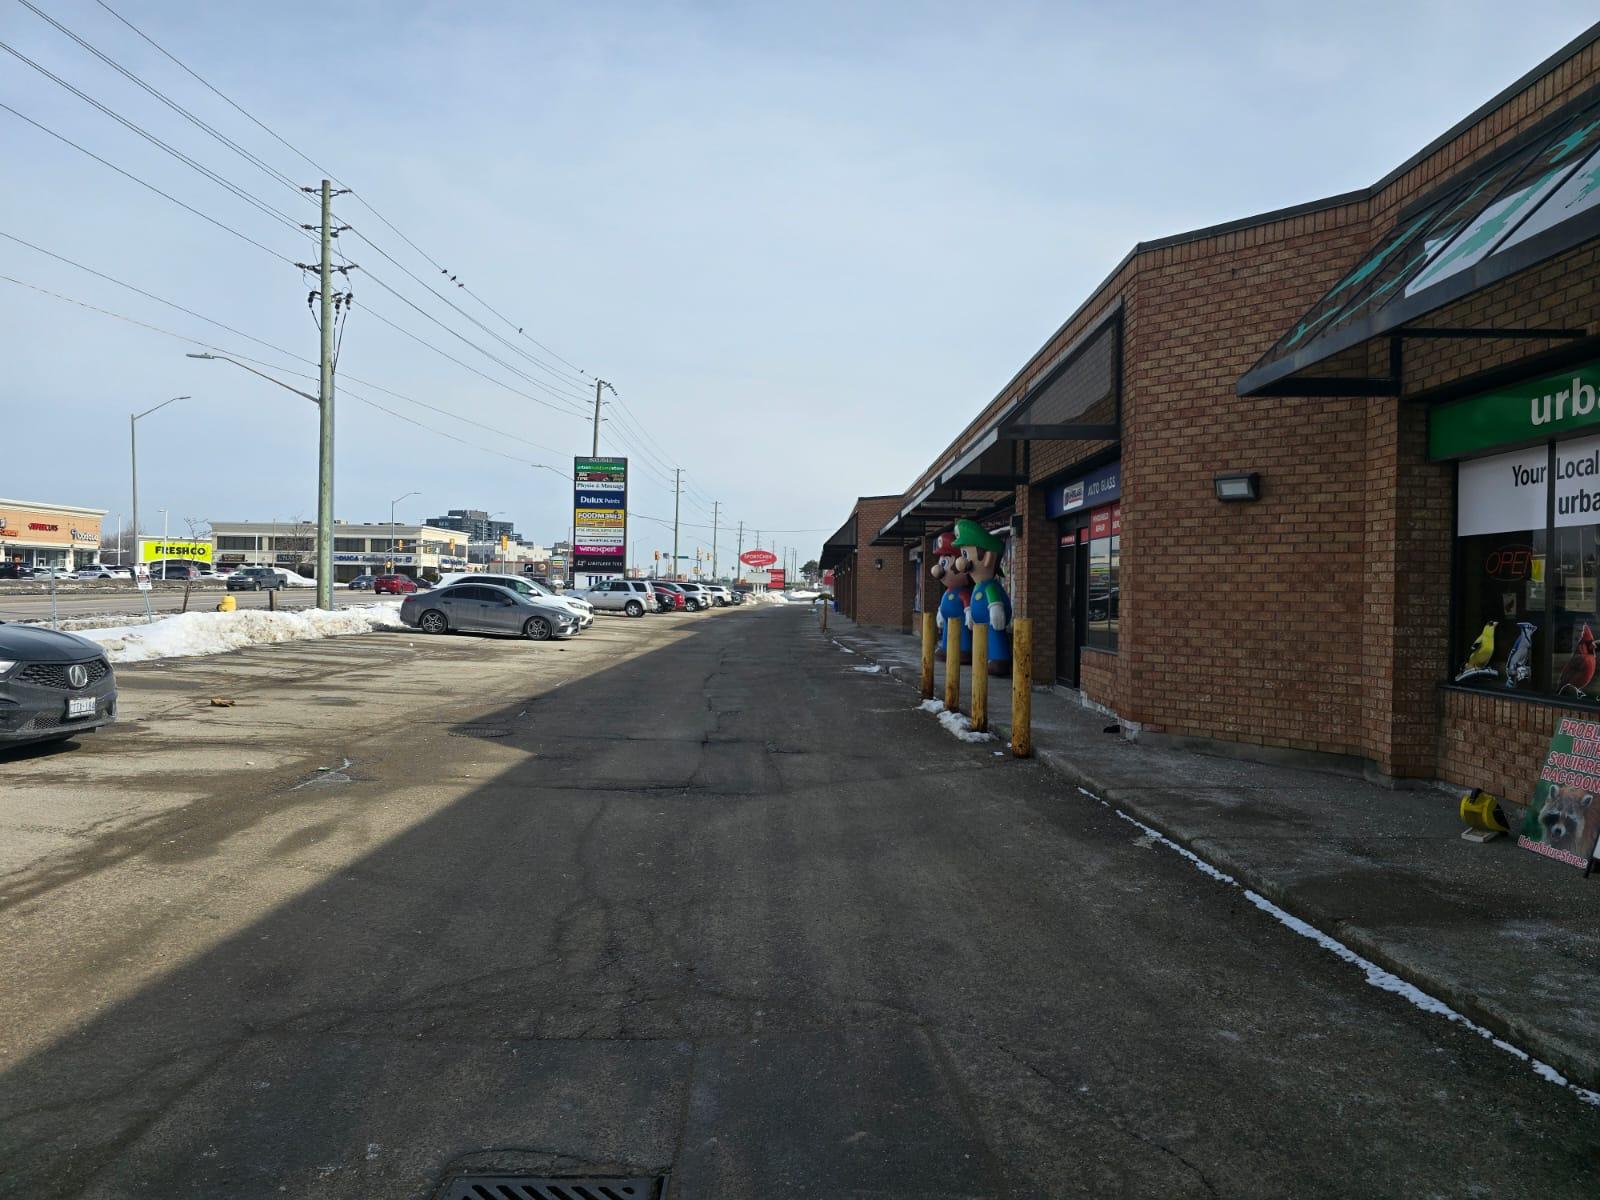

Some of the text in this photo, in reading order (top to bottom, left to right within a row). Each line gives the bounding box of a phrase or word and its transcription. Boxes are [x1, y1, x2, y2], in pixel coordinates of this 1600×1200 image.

[1531, 377, 1600, 426] urb
[1512, 450, 1599, 487] Your Local
[1088, 476, 1116, 496] AUTO GLASS
[1559, 489, 1600, 515] urba
[1548, 751, 1600, 776] SQUIRRE
